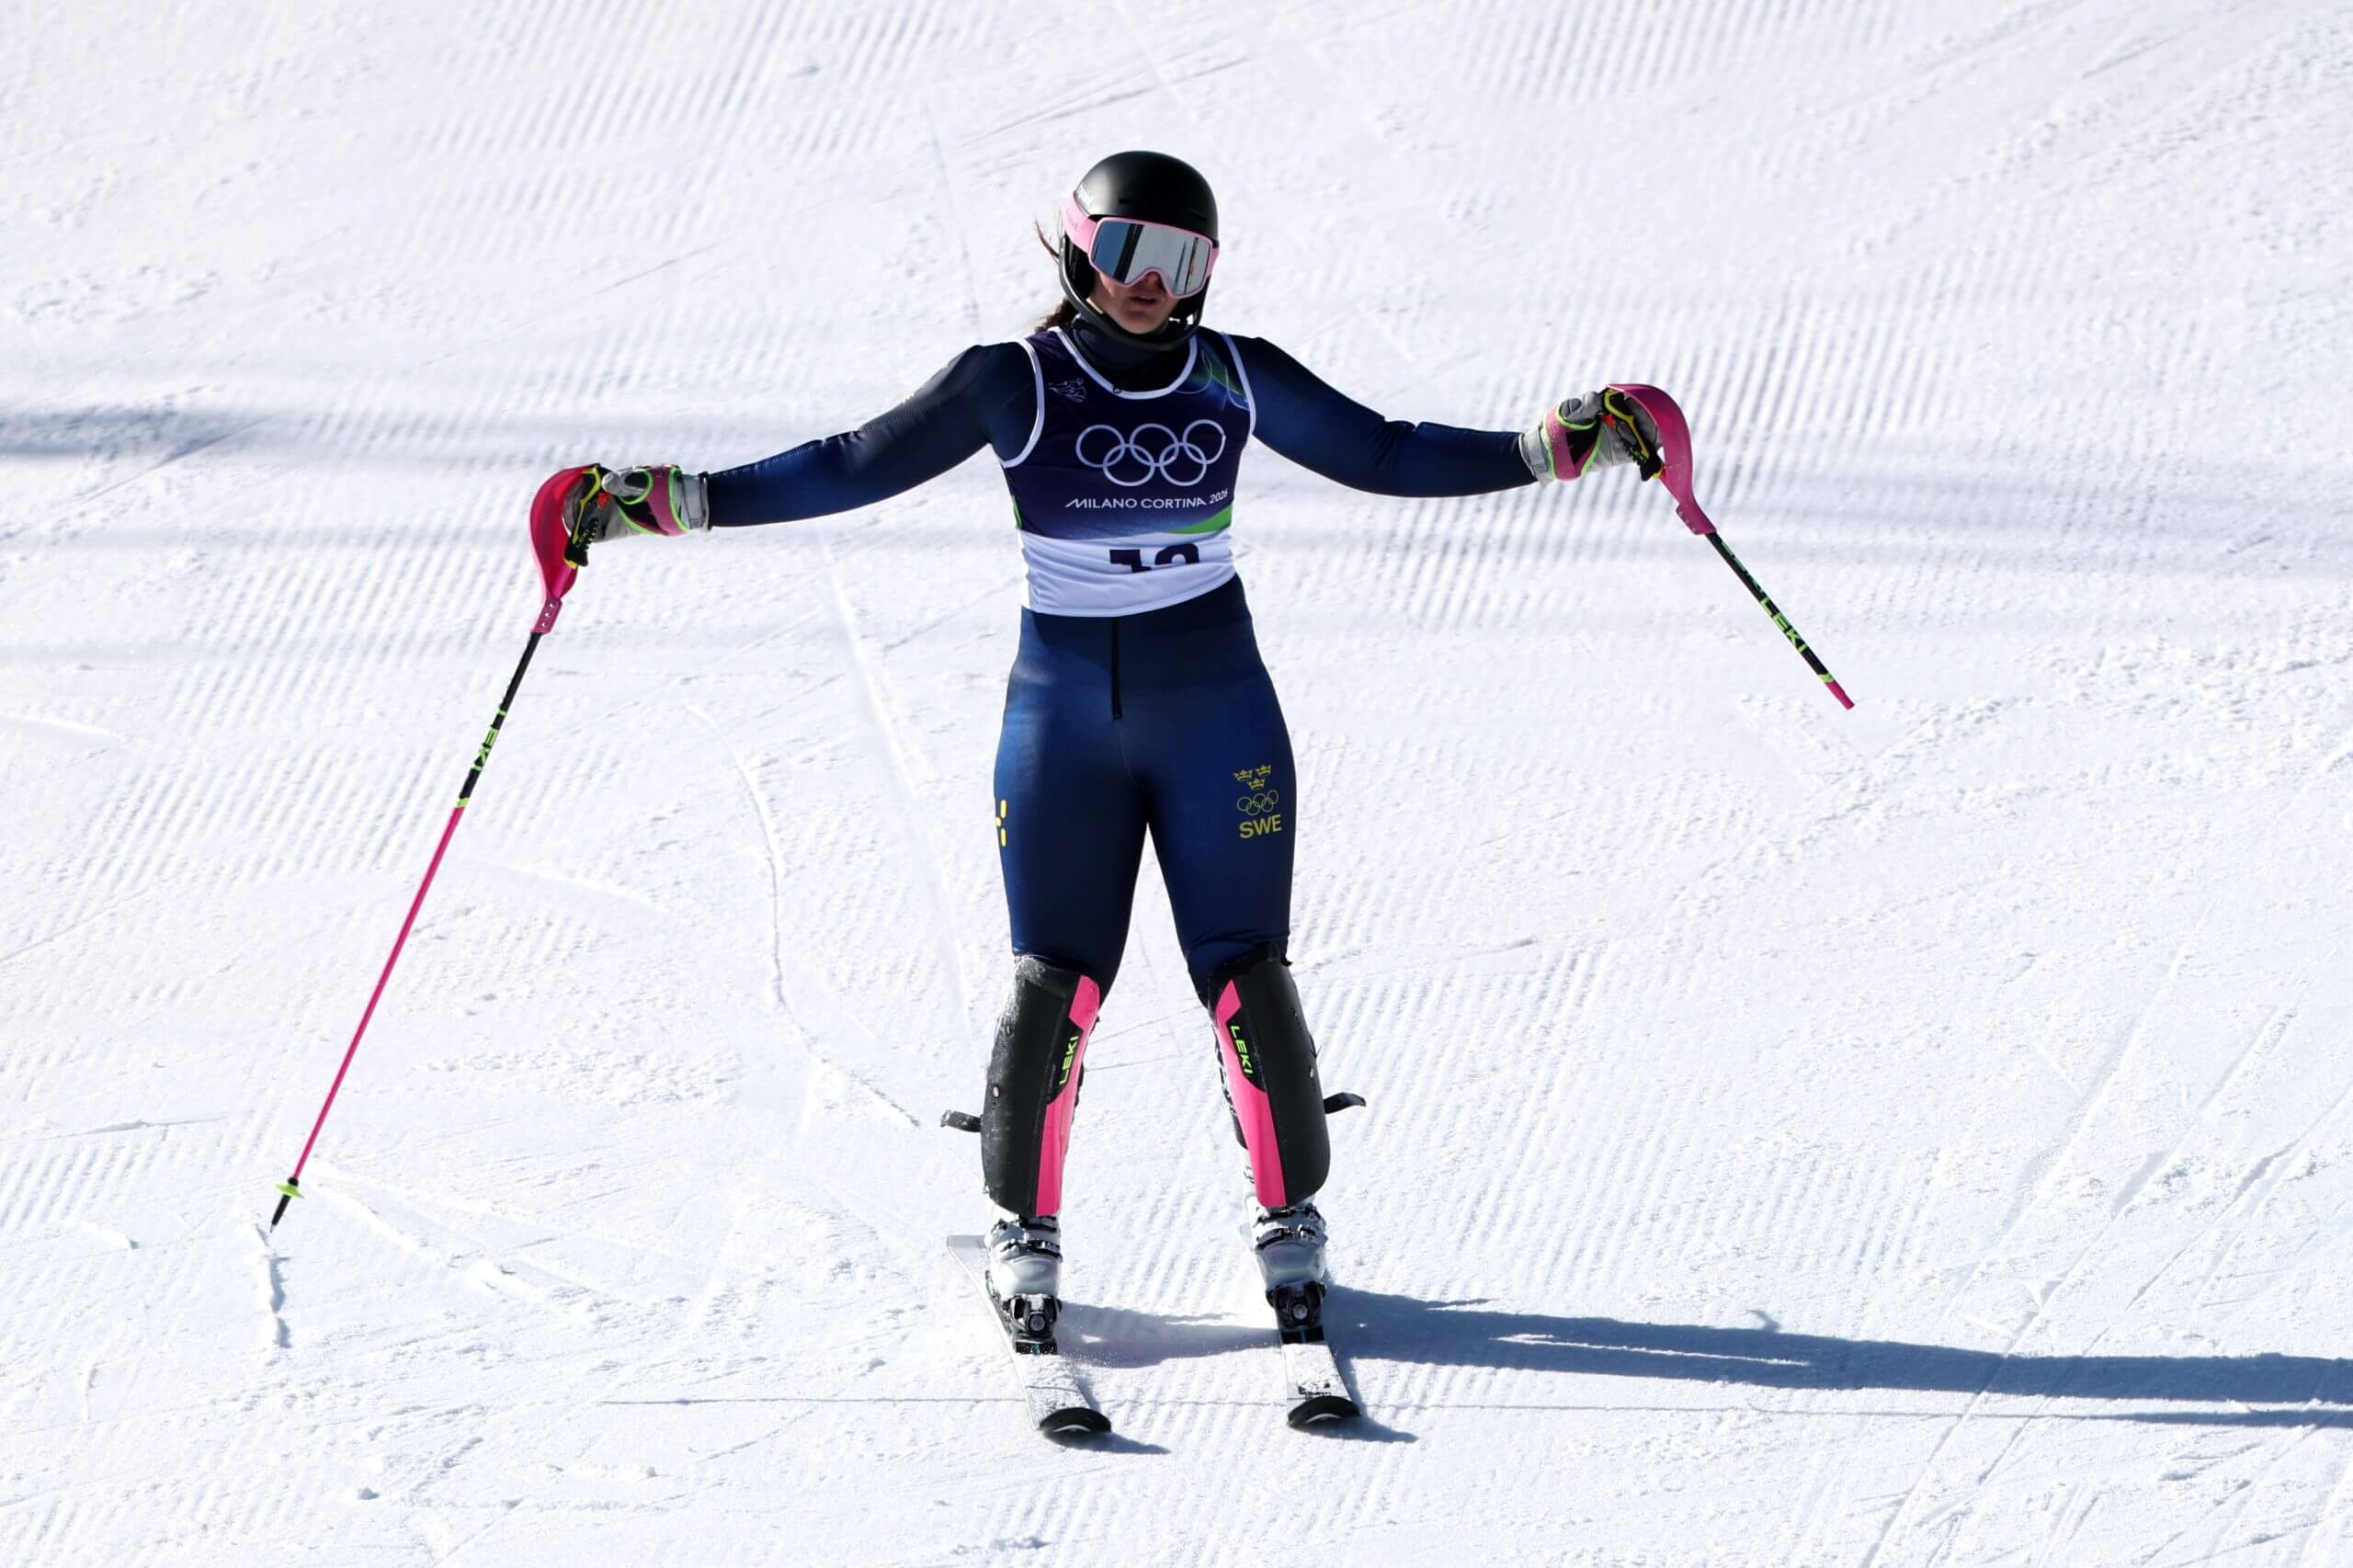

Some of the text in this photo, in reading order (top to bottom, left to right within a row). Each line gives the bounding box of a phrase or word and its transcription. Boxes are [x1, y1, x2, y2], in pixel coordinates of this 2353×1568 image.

[1064, 488, 1228, 508] MILANO CORTINA 2026
[1759, 597, 1809, 653] LEKI
[1239, 813, 1282, 839] SWE
[1059, 1036, 1079, 1085] LEKI
[1230, 1025, 1254, 1074] LEKI
